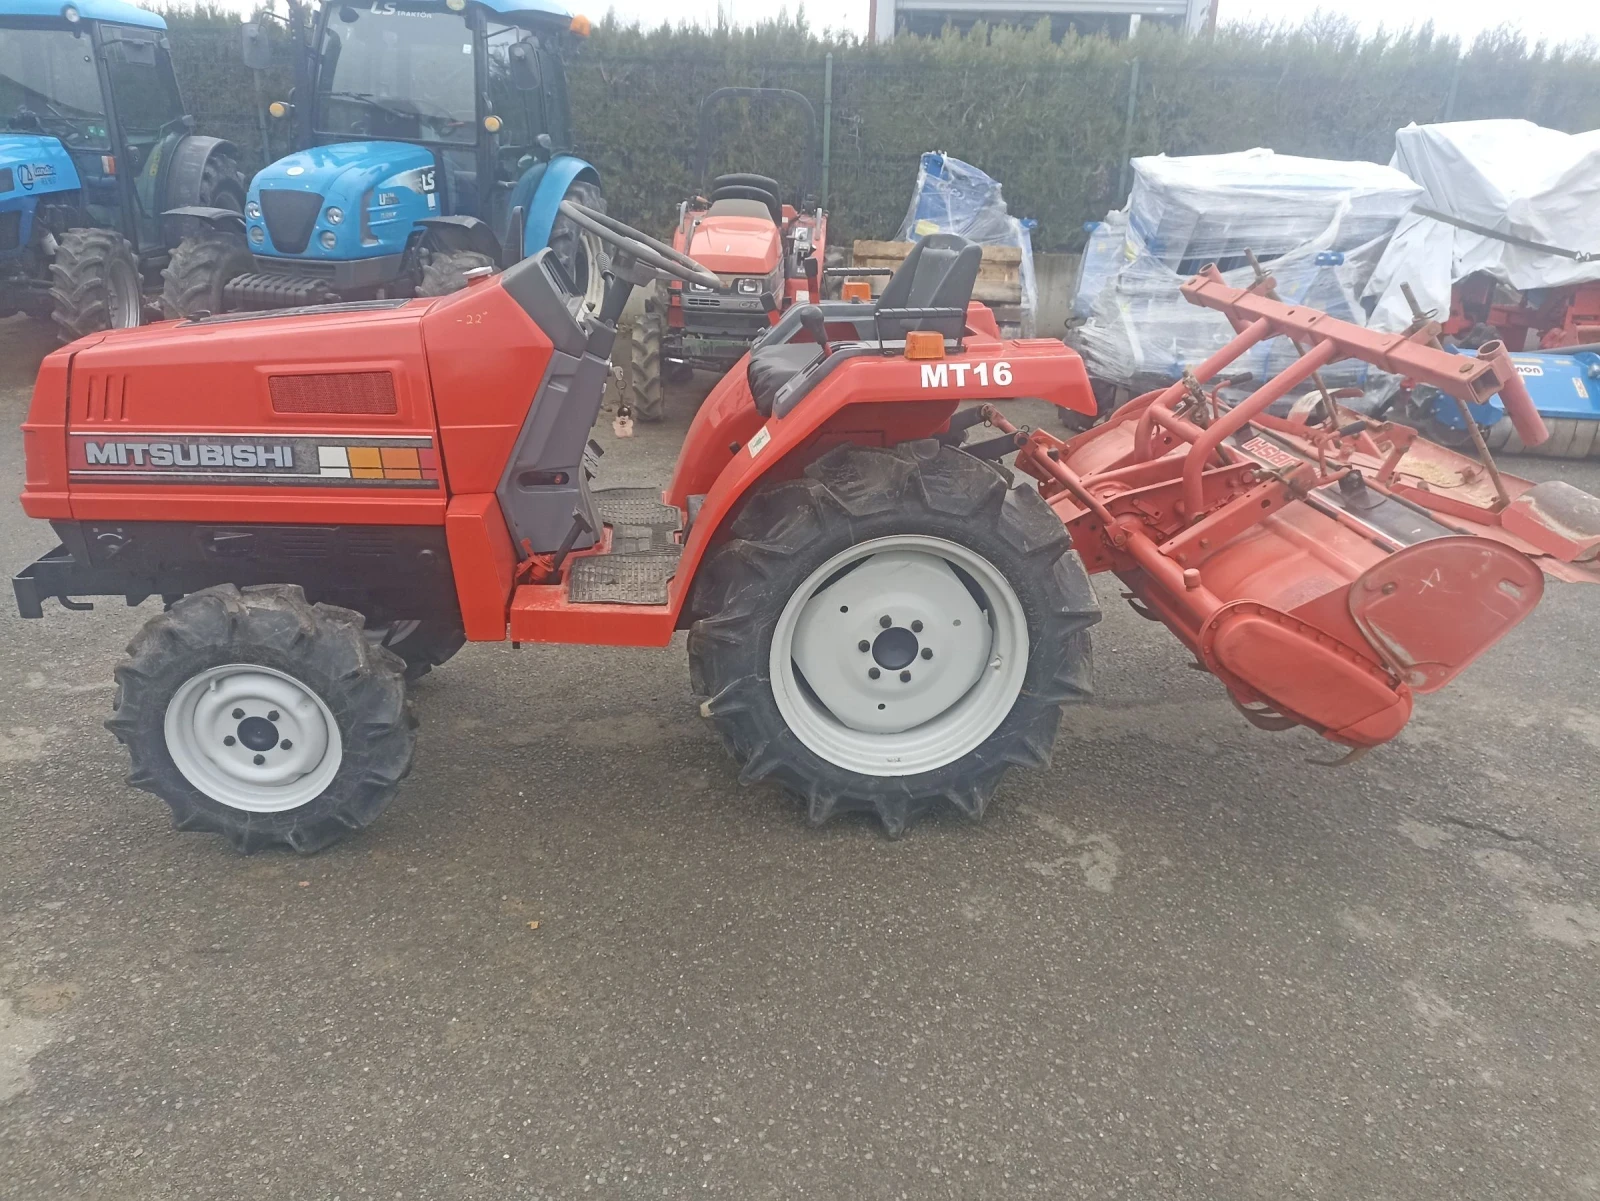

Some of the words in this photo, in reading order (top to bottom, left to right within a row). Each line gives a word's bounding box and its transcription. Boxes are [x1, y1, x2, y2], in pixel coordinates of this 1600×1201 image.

[371, 0, 397, 15] LS
[421, 171, 435, 191] LS
[920, 361, 1014, 388] MT16
[1516, 366, 1541, 375] non
[85, 442, 293, 468] MITSUBISHI
